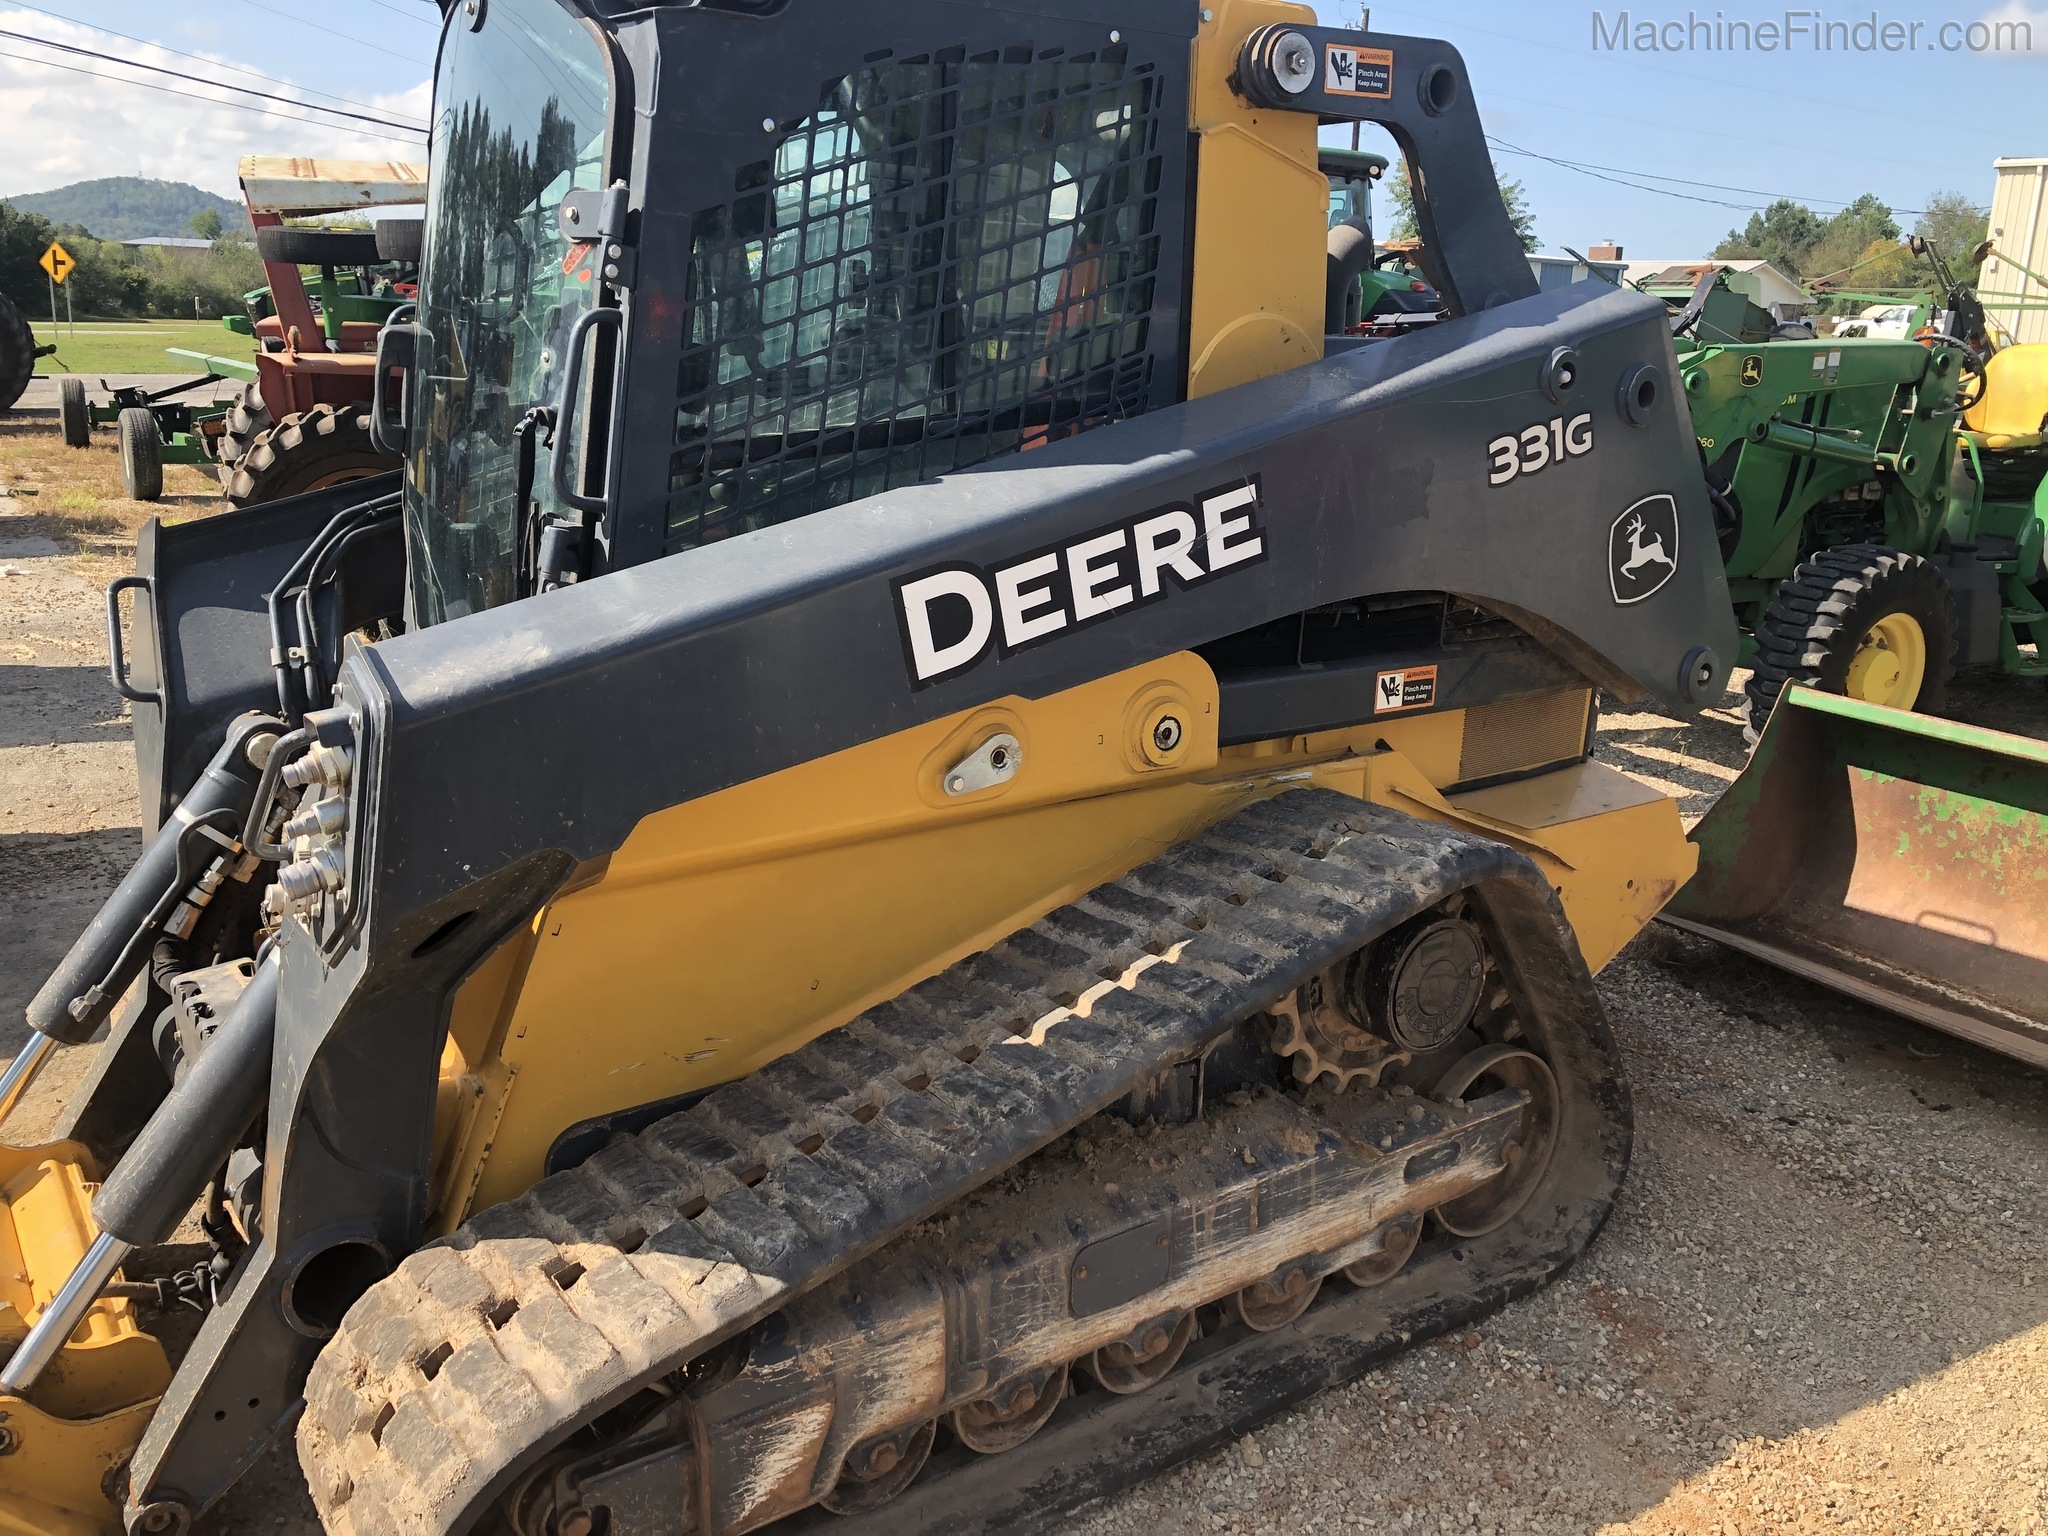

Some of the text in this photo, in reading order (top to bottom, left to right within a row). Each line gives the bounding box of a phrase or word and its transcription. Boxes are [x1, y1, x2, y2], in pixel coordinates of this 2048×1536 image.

[1365, 53, 1389, 61] WARNING
[1358, 69, 1374, 77] Pinch
[1370, 81, 1383, 89] Away
[1488, 413, 1592, 485] 331G
[900, 483, 1263, 681] DEERE
[1411, 669, 1433, 677] WARNING
